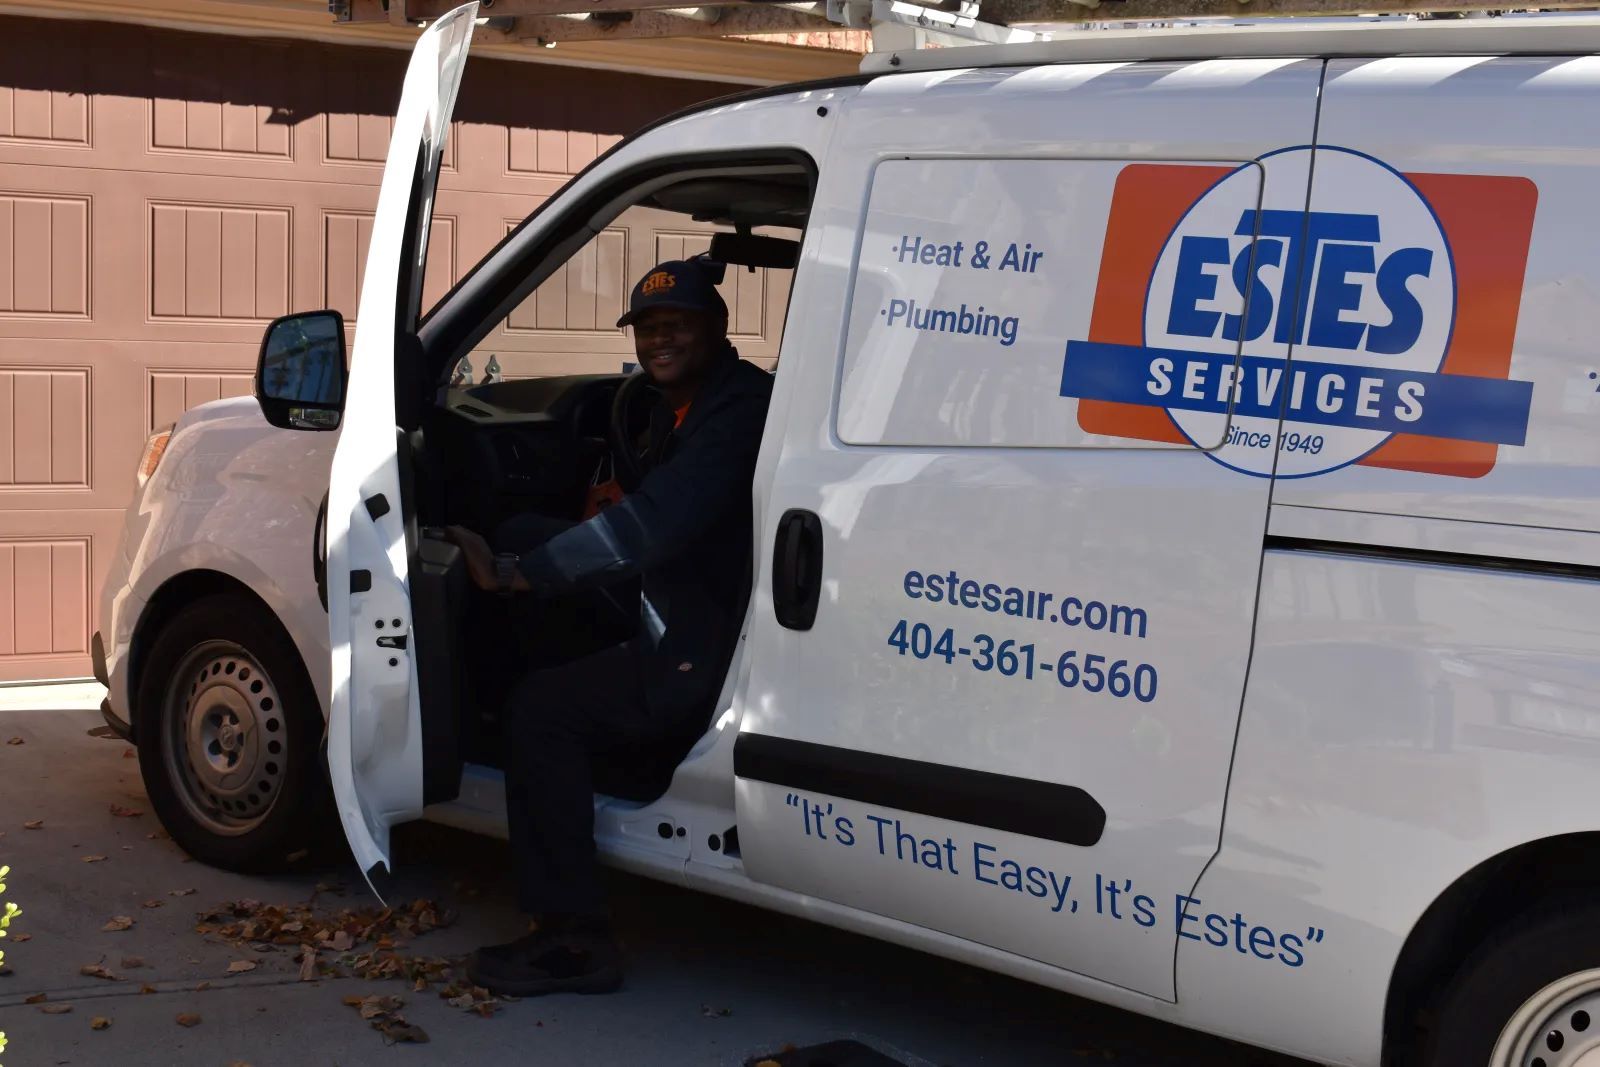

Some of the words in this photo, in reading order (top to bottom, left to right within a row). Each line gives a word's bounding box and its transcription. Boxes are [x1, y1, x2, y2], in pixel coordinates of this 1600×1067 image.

[642, 271, 676, 294] ESTES
[970, 241, 990, 270] &
[999, 243, 1044, 273] Air
[1166, 209, 1434, 355] ESTES
[1146, 357, 1425, 421] SERVICES
[1223, 425, 1272, 449] Since
[1279, 431, 1324, 455] 1949
[887, 619, 1158, 703] 404-361-6560
[867, 815, 959, 875] That
[973, 842, 1079, 915] Easy,
